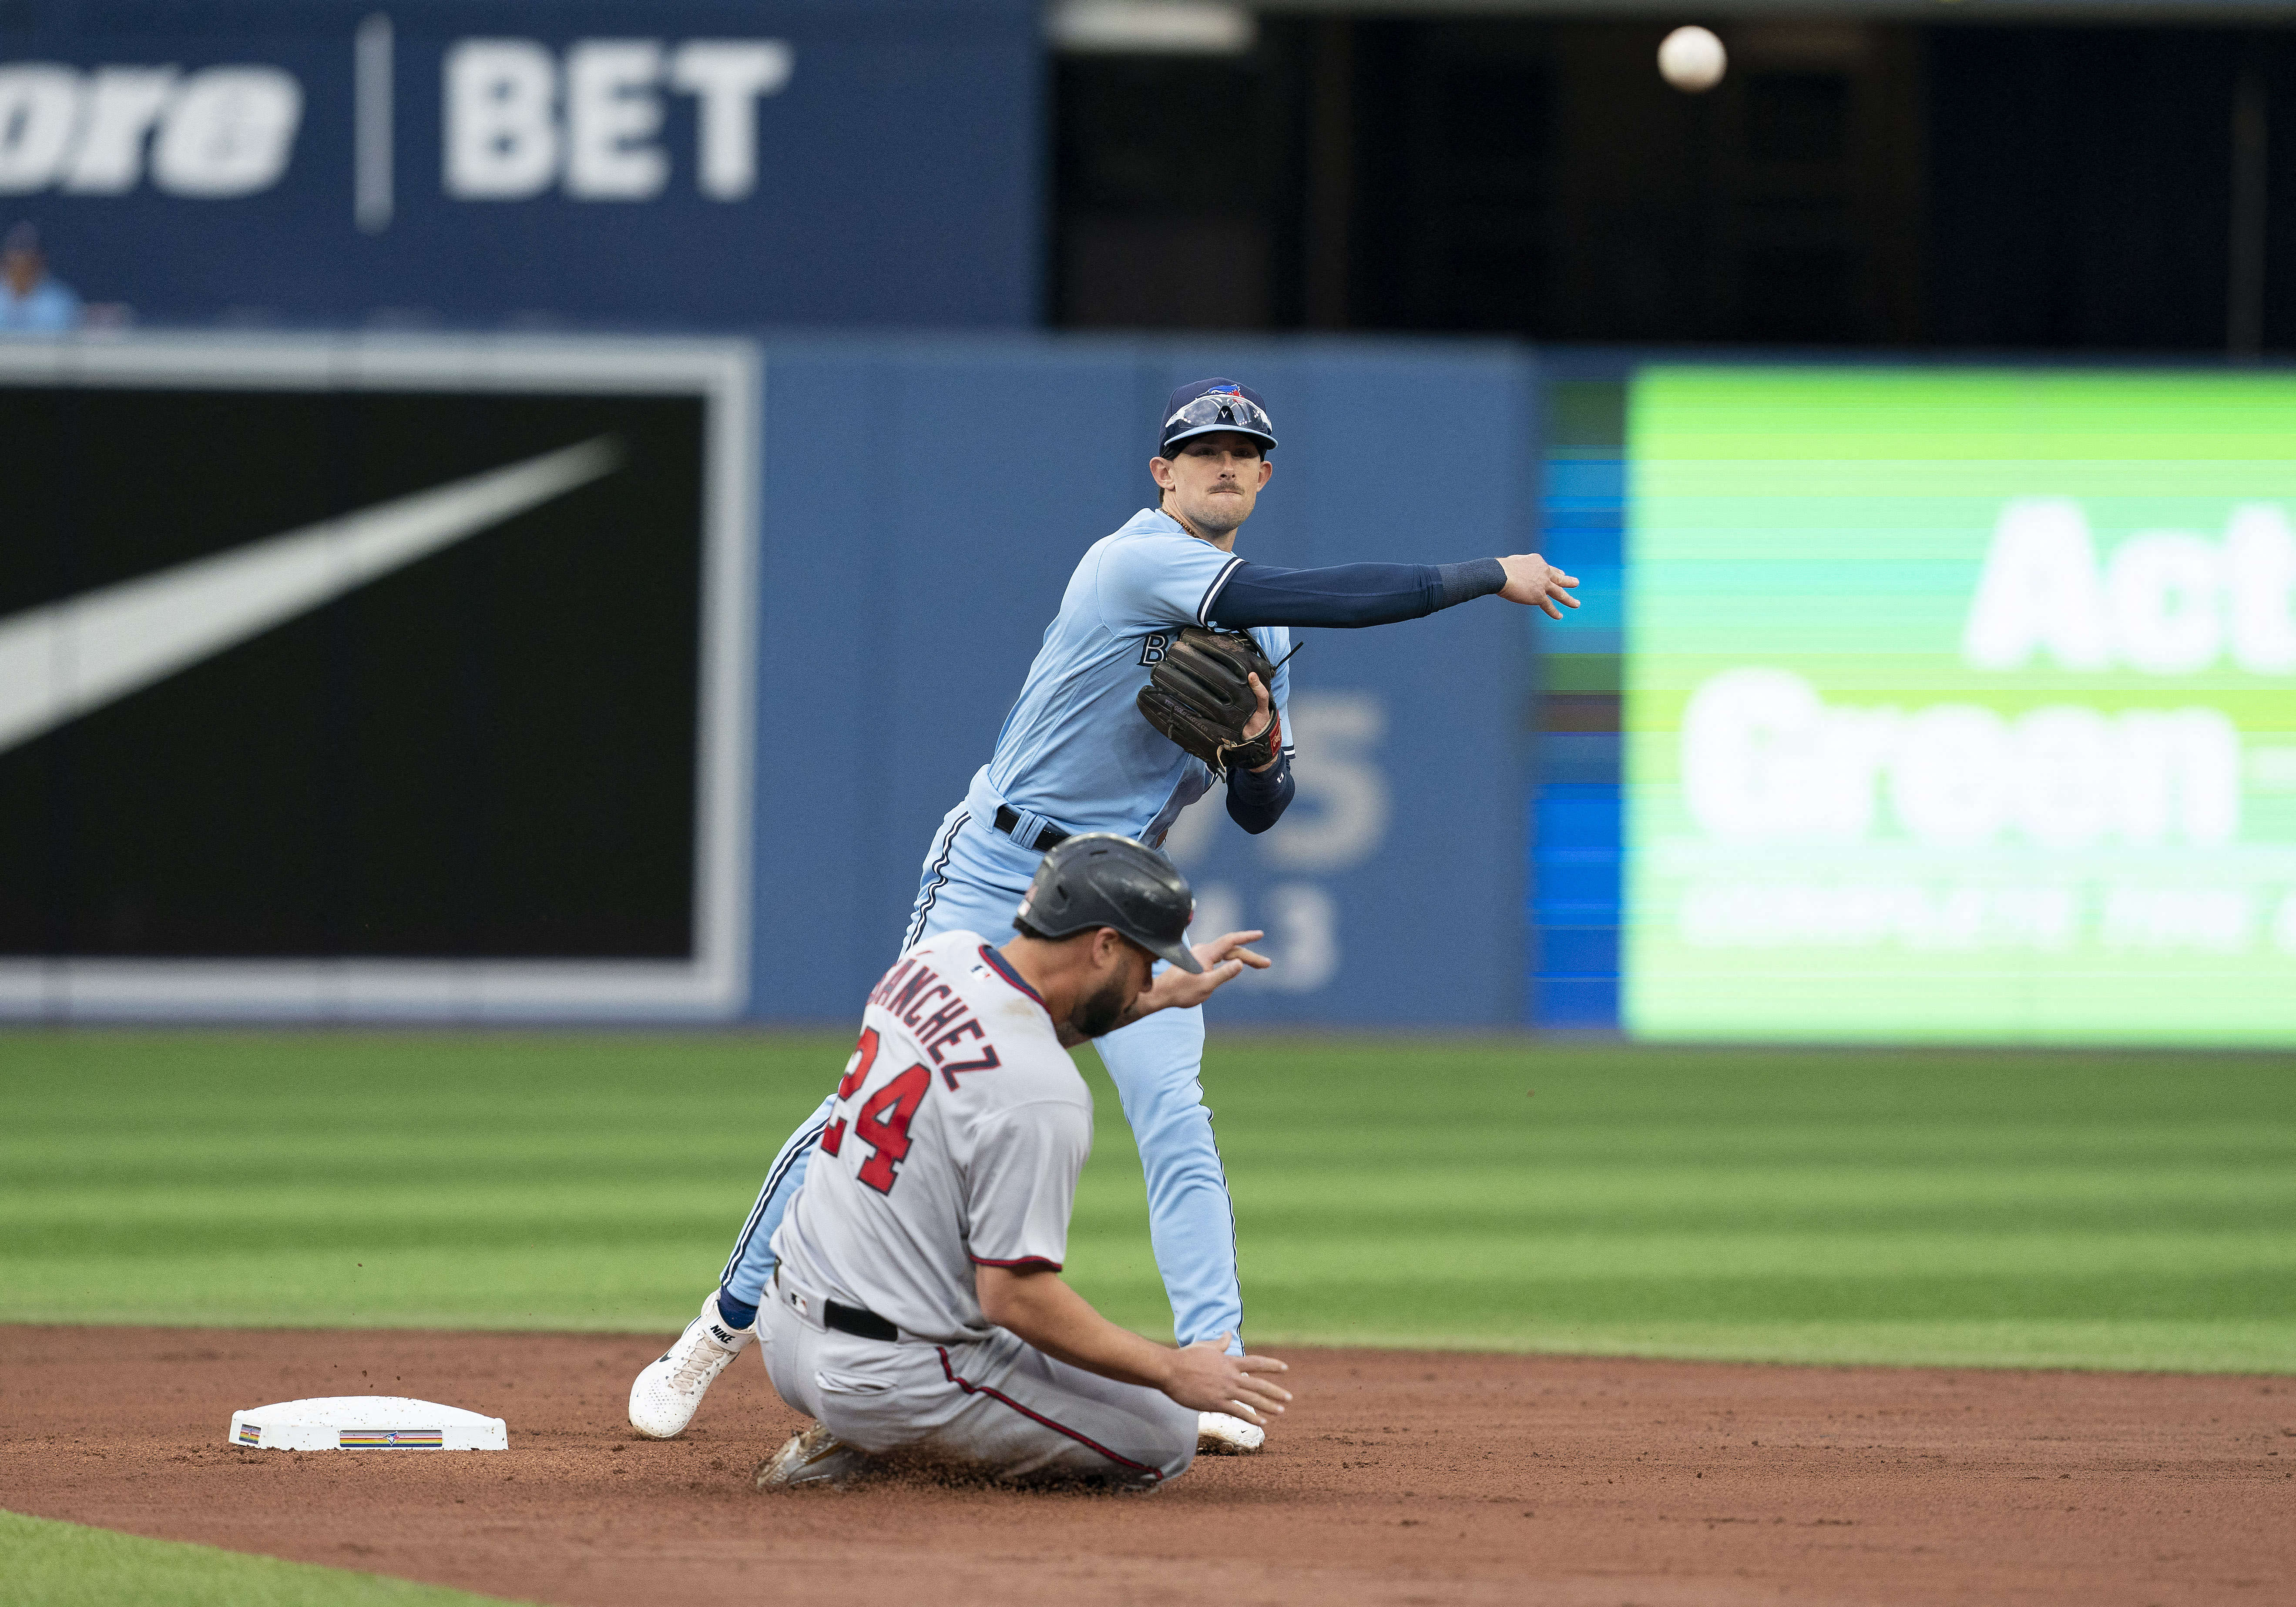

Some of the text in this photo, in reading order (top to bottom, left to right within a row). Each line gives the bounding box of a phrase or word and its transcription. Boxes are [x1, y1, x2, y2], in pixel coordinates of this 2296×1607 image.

[443, 38, 793, 200] BET
[821, 1026, 931, 1196] 24
[710, 1325, 735, 1344] NIKE
